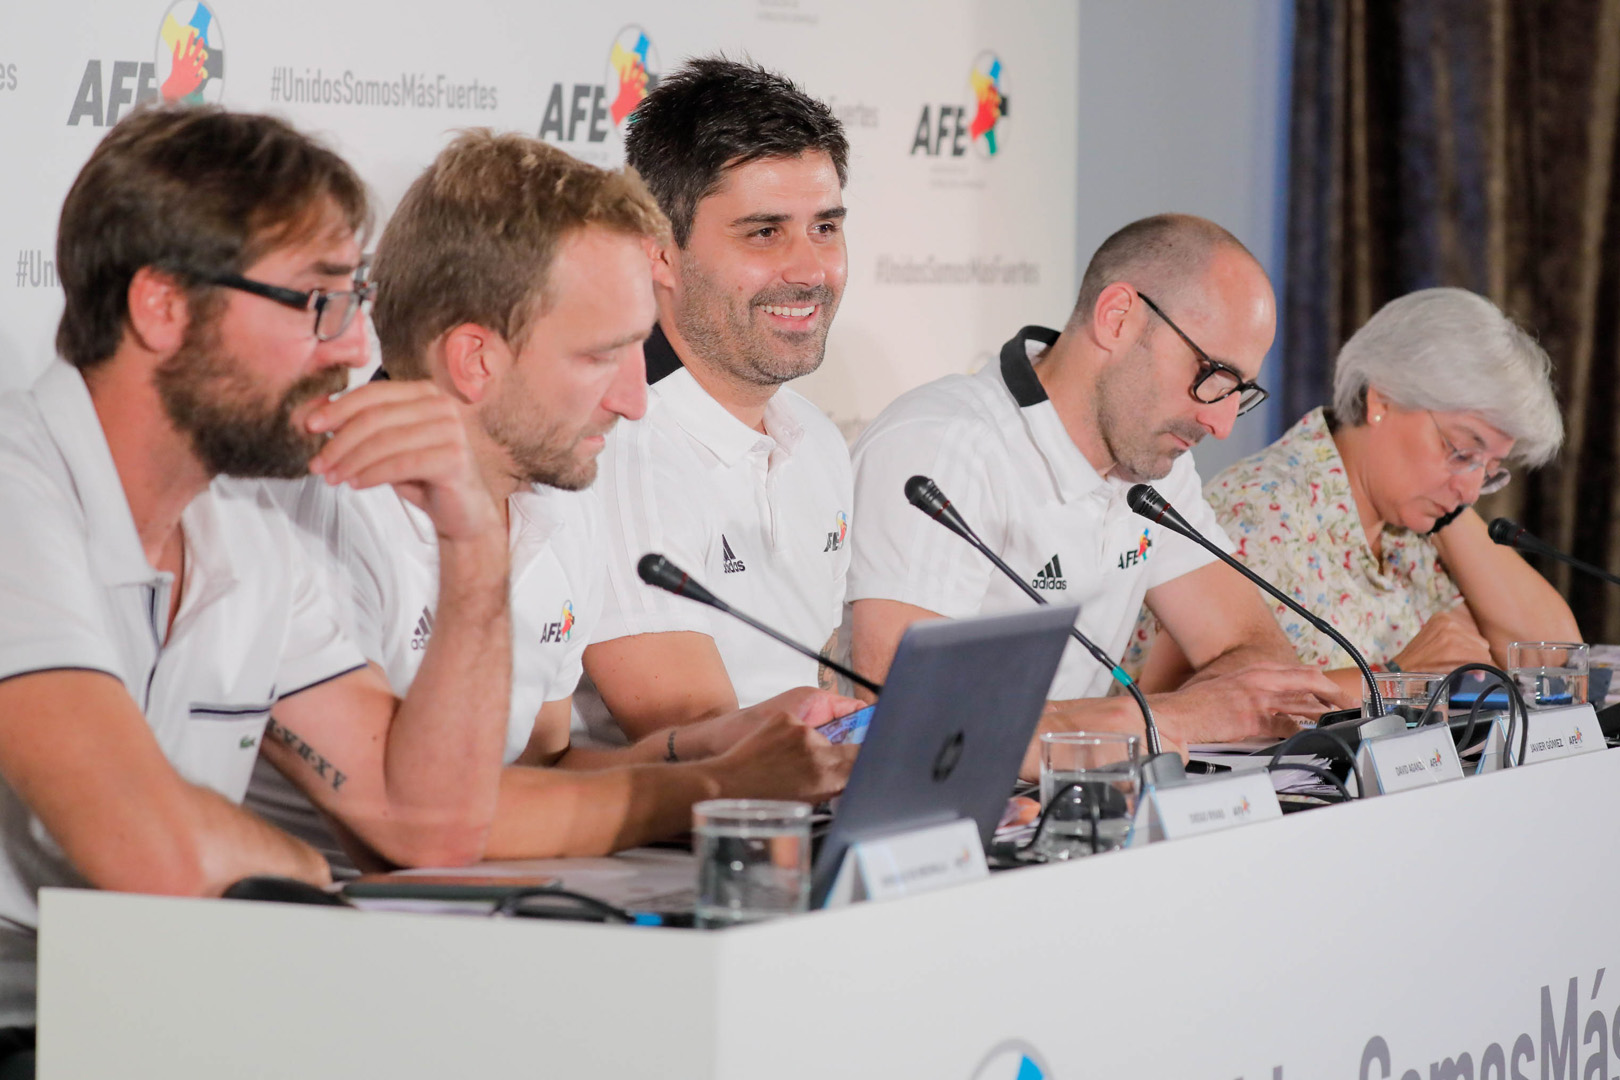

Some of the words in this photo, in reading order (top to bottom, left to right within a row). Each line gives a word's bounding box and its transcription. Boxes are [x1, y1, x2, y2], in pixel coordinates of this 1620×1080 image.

[271, 67, 498, 110] #UnidosSomosMásFuertes
[538, 83, 608, 142] AFE
[909, 104, 967, 156] AFE
[1118, 549, 1138, 569] AFE
[1032, 577, 1067, 590] adidas
[540, 622, 561, 643] AFE
